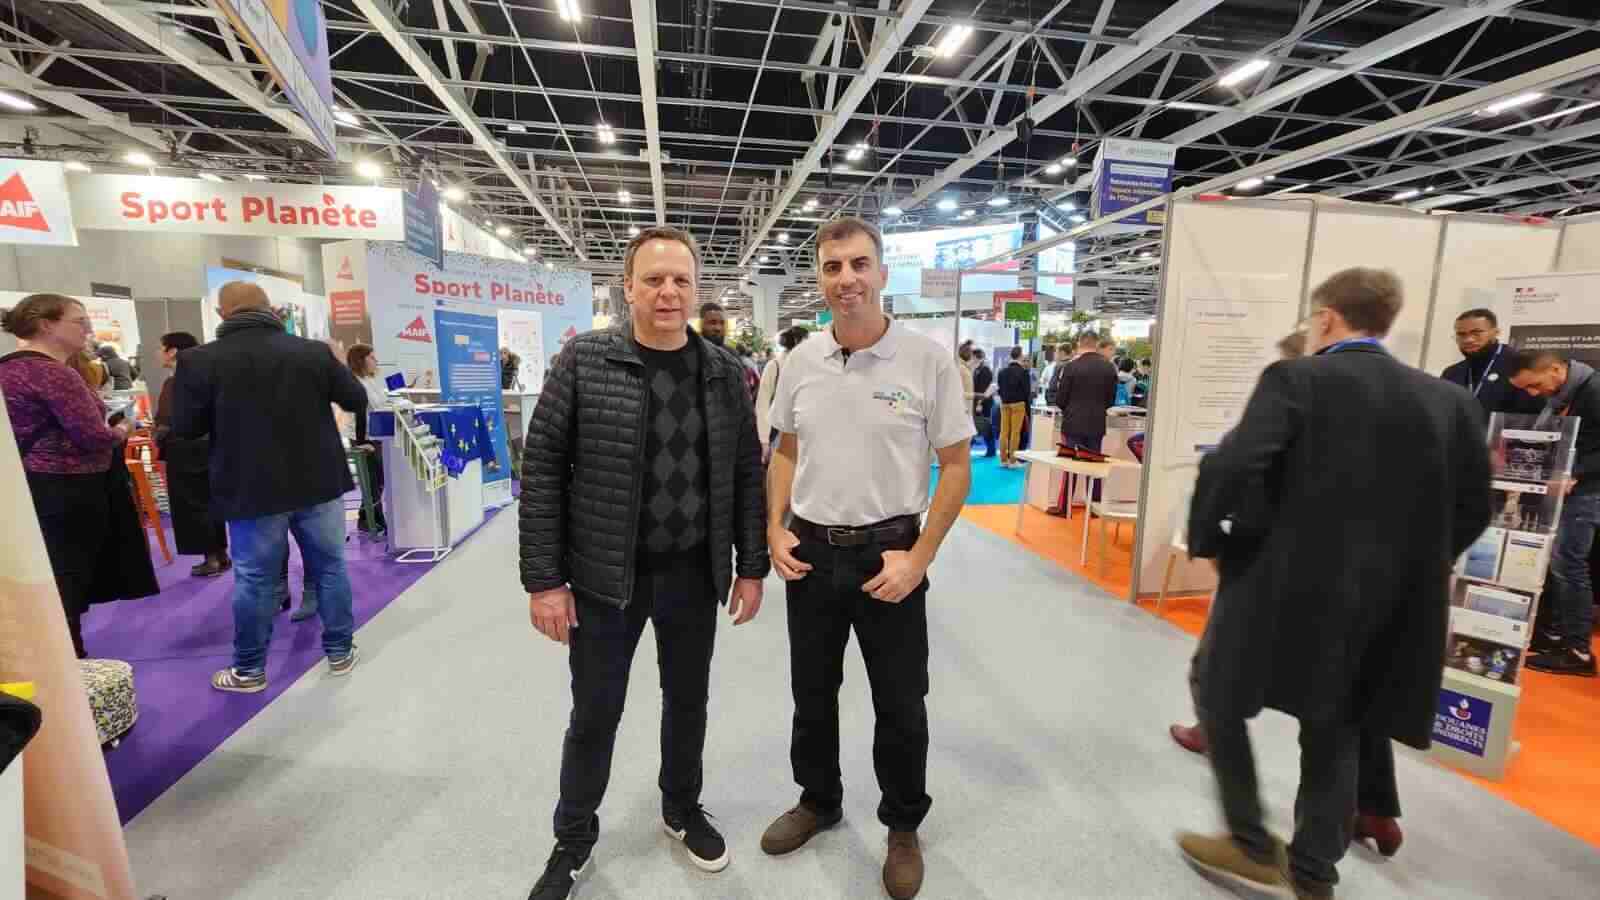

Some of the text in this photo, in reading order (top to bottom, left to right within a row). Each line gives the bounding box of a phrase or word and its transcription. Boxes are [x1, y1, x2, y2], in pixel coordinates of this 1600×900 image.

[0, 200, 38, 217] AIF
[120, 191, 227, 223] Sport
[241, 193, 377, 228] Planète
[415, 273, 565, 305] Sport Planète
